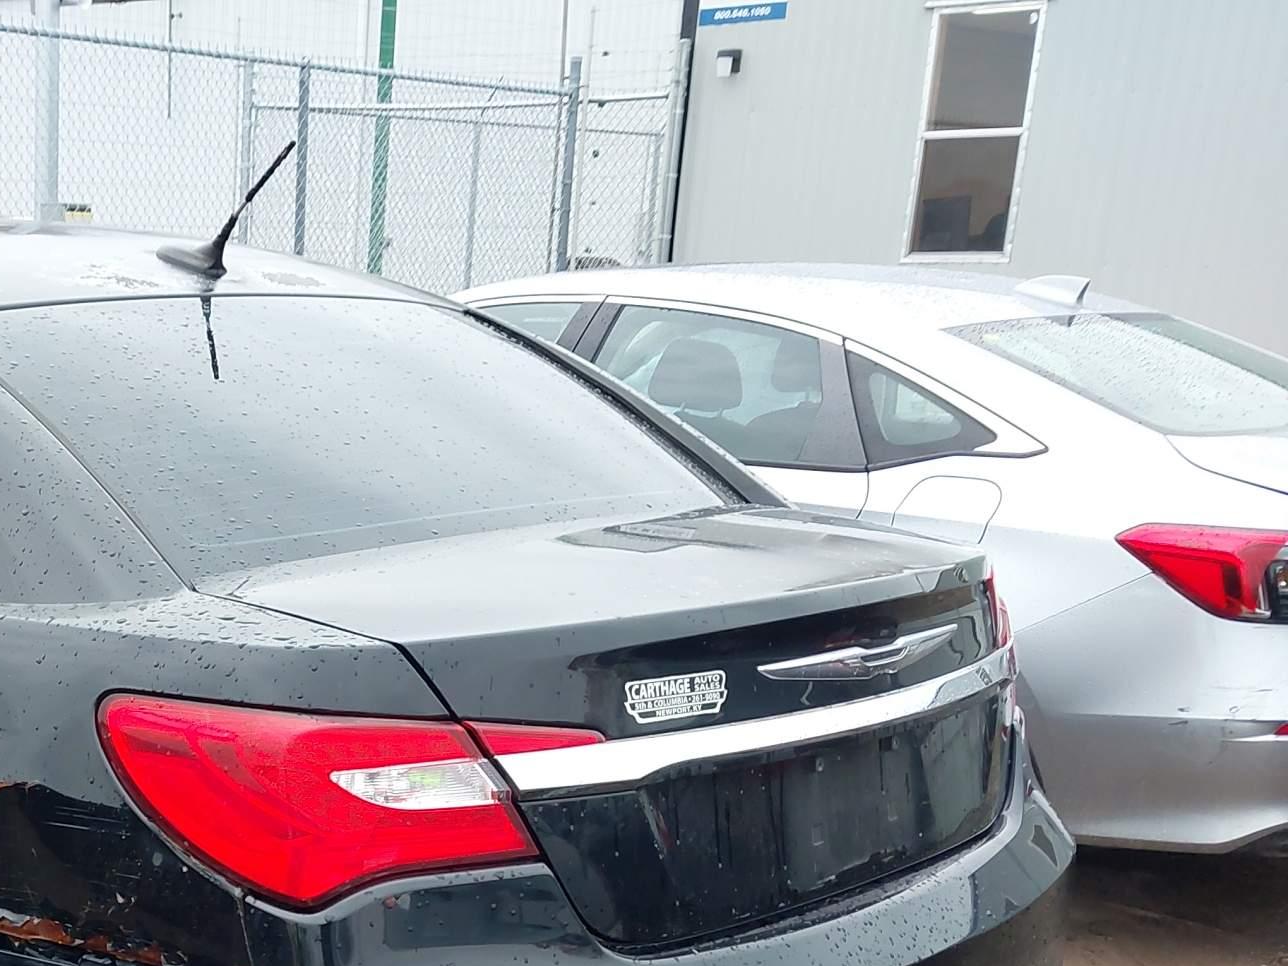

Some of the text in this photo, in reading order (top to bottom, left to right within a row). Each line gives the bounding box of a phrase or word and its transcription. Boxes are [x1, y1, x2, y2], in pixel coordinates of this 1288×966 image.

[694, 674, 720, 684] AUTO
[631, 678, 691, 700] CARTHAGE
[694, 682, 721, 692] SALES
